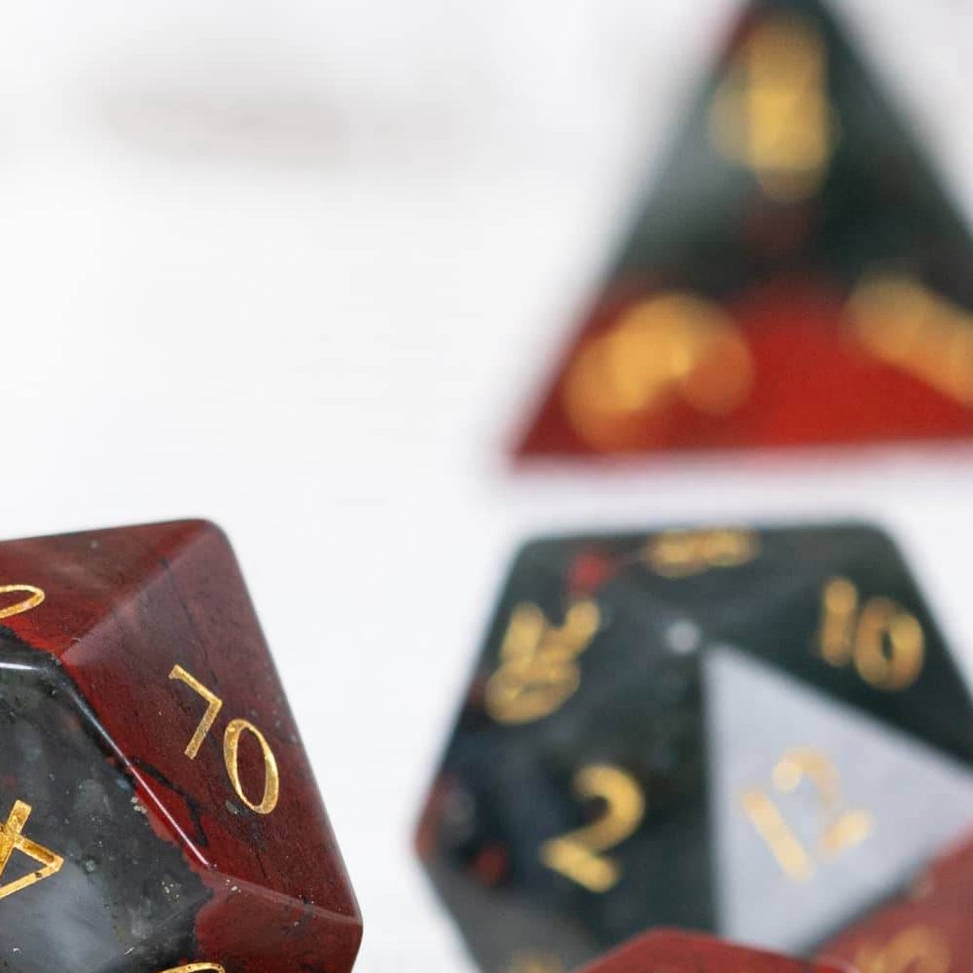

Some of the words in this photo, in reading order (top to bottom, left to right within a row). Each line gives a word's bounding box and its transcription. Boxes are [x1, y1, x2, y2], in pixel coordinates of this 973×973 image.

[819, 575, 924, 692] 10
[168, 663, 280, 815] 70
[539, 763, 645, 893] 2
